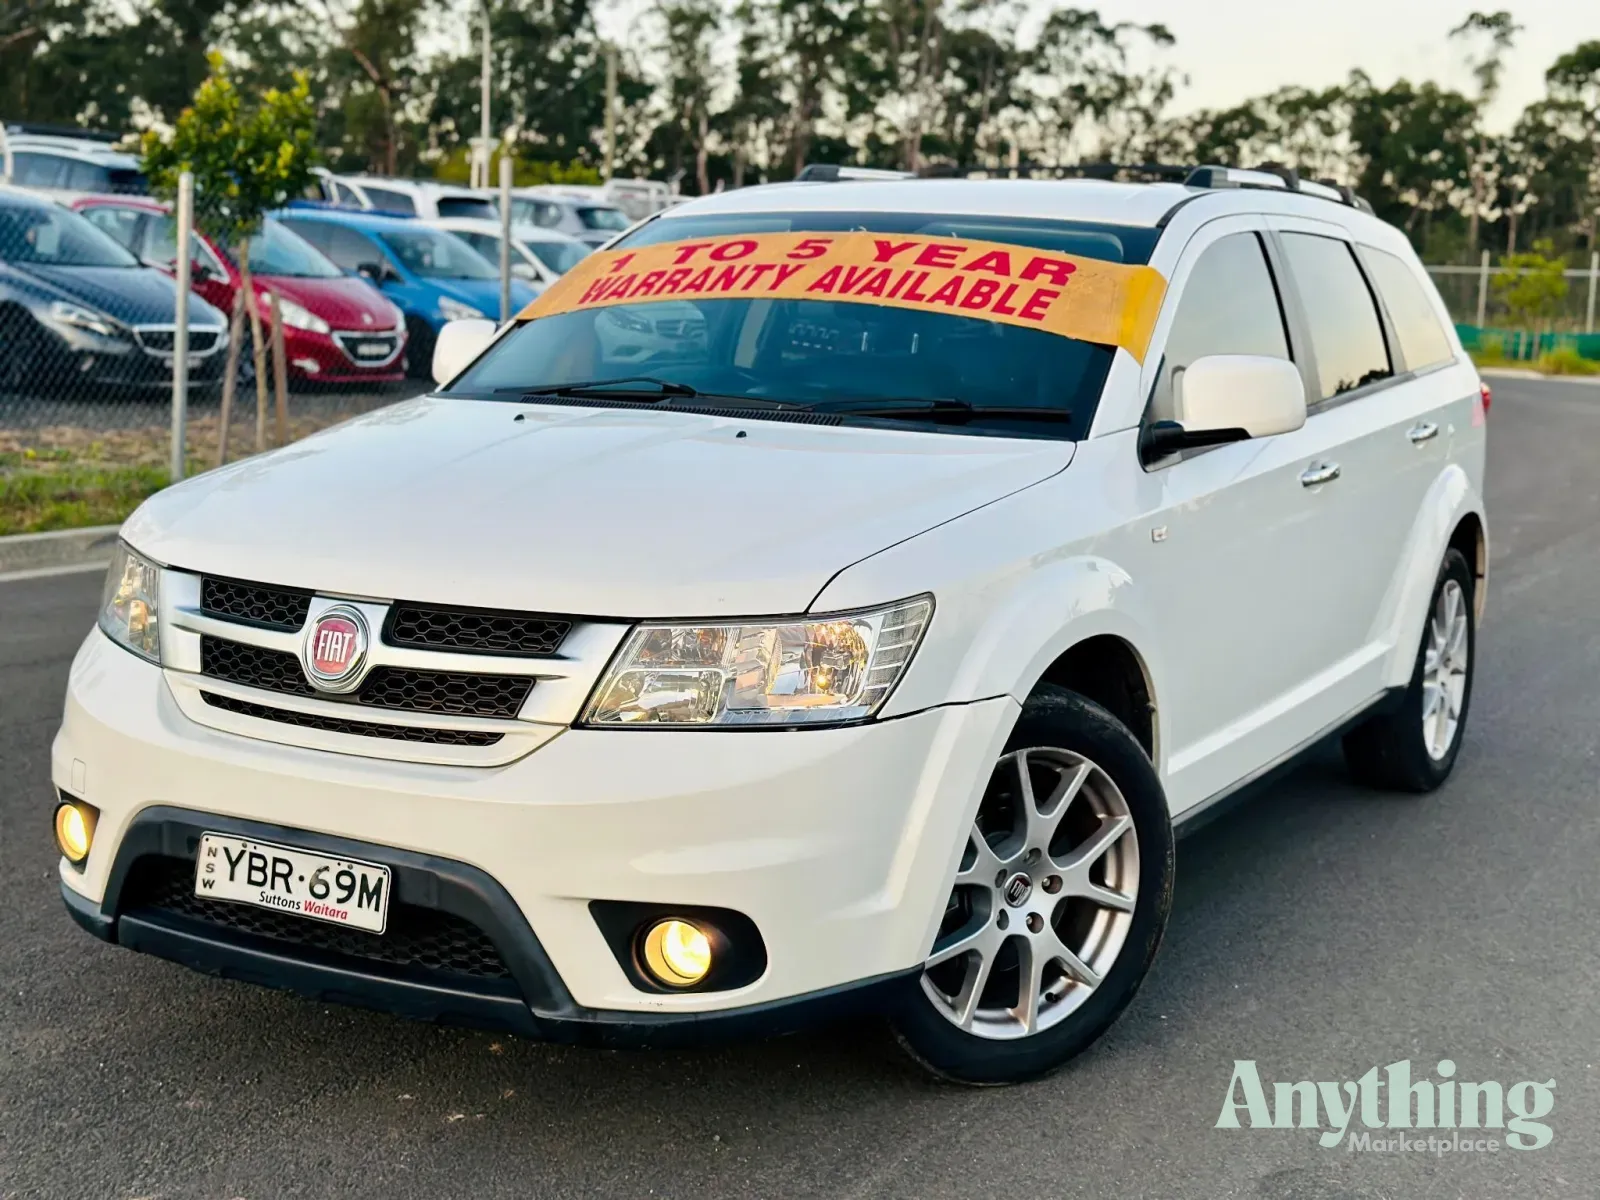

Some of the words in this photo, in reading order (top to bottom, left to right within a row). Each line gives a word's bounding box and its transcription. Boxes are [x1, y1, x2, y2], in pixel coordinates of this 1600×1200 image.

[608, 252, 637, 273] 1
[672, 239, 759, 265] TO
[786, 239, 834, 259] 5
[873, 240, 1077, 287] YEAR
[577, 264, 807, 304] WARRANTY
[804, 265, 1061, 321] AVAILABLE
[317, 629, 354, 663] FIAT
[259, 890, 301, 910] Suttons
[303, 899, 348, 920] Waitara
